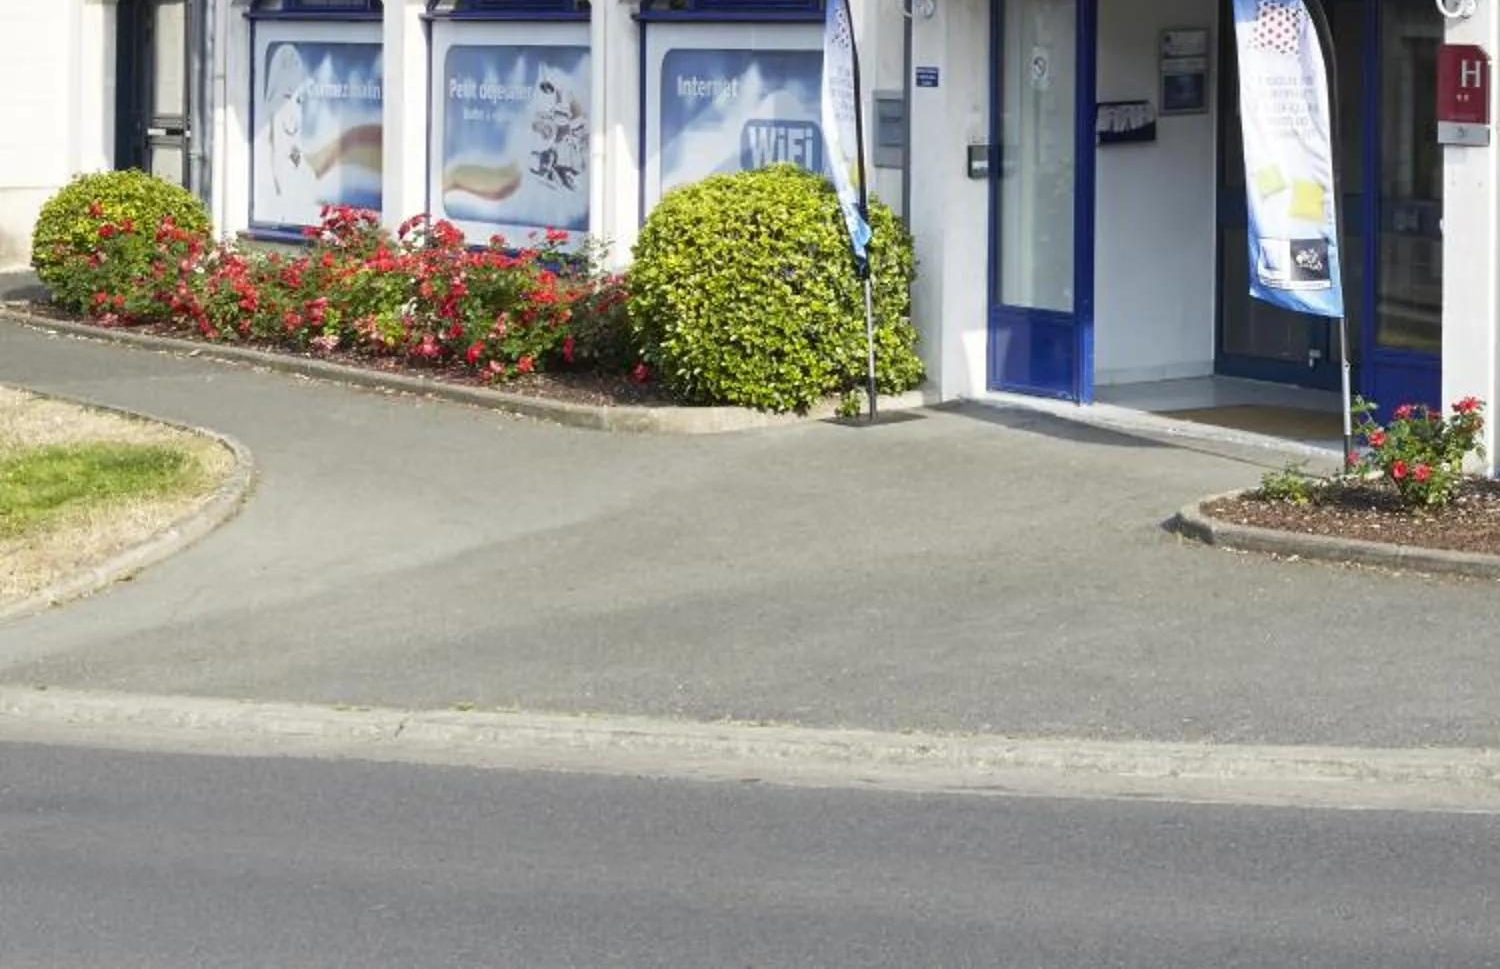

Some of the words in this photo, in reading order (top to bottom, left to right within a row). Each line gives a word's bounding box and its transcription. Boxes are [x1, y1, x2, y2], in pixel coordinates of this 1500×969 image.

[677, 75, 738, 97] Internet
[1461, 59, 1481, 88] H
[746, 126, 813, 171] WiFi
